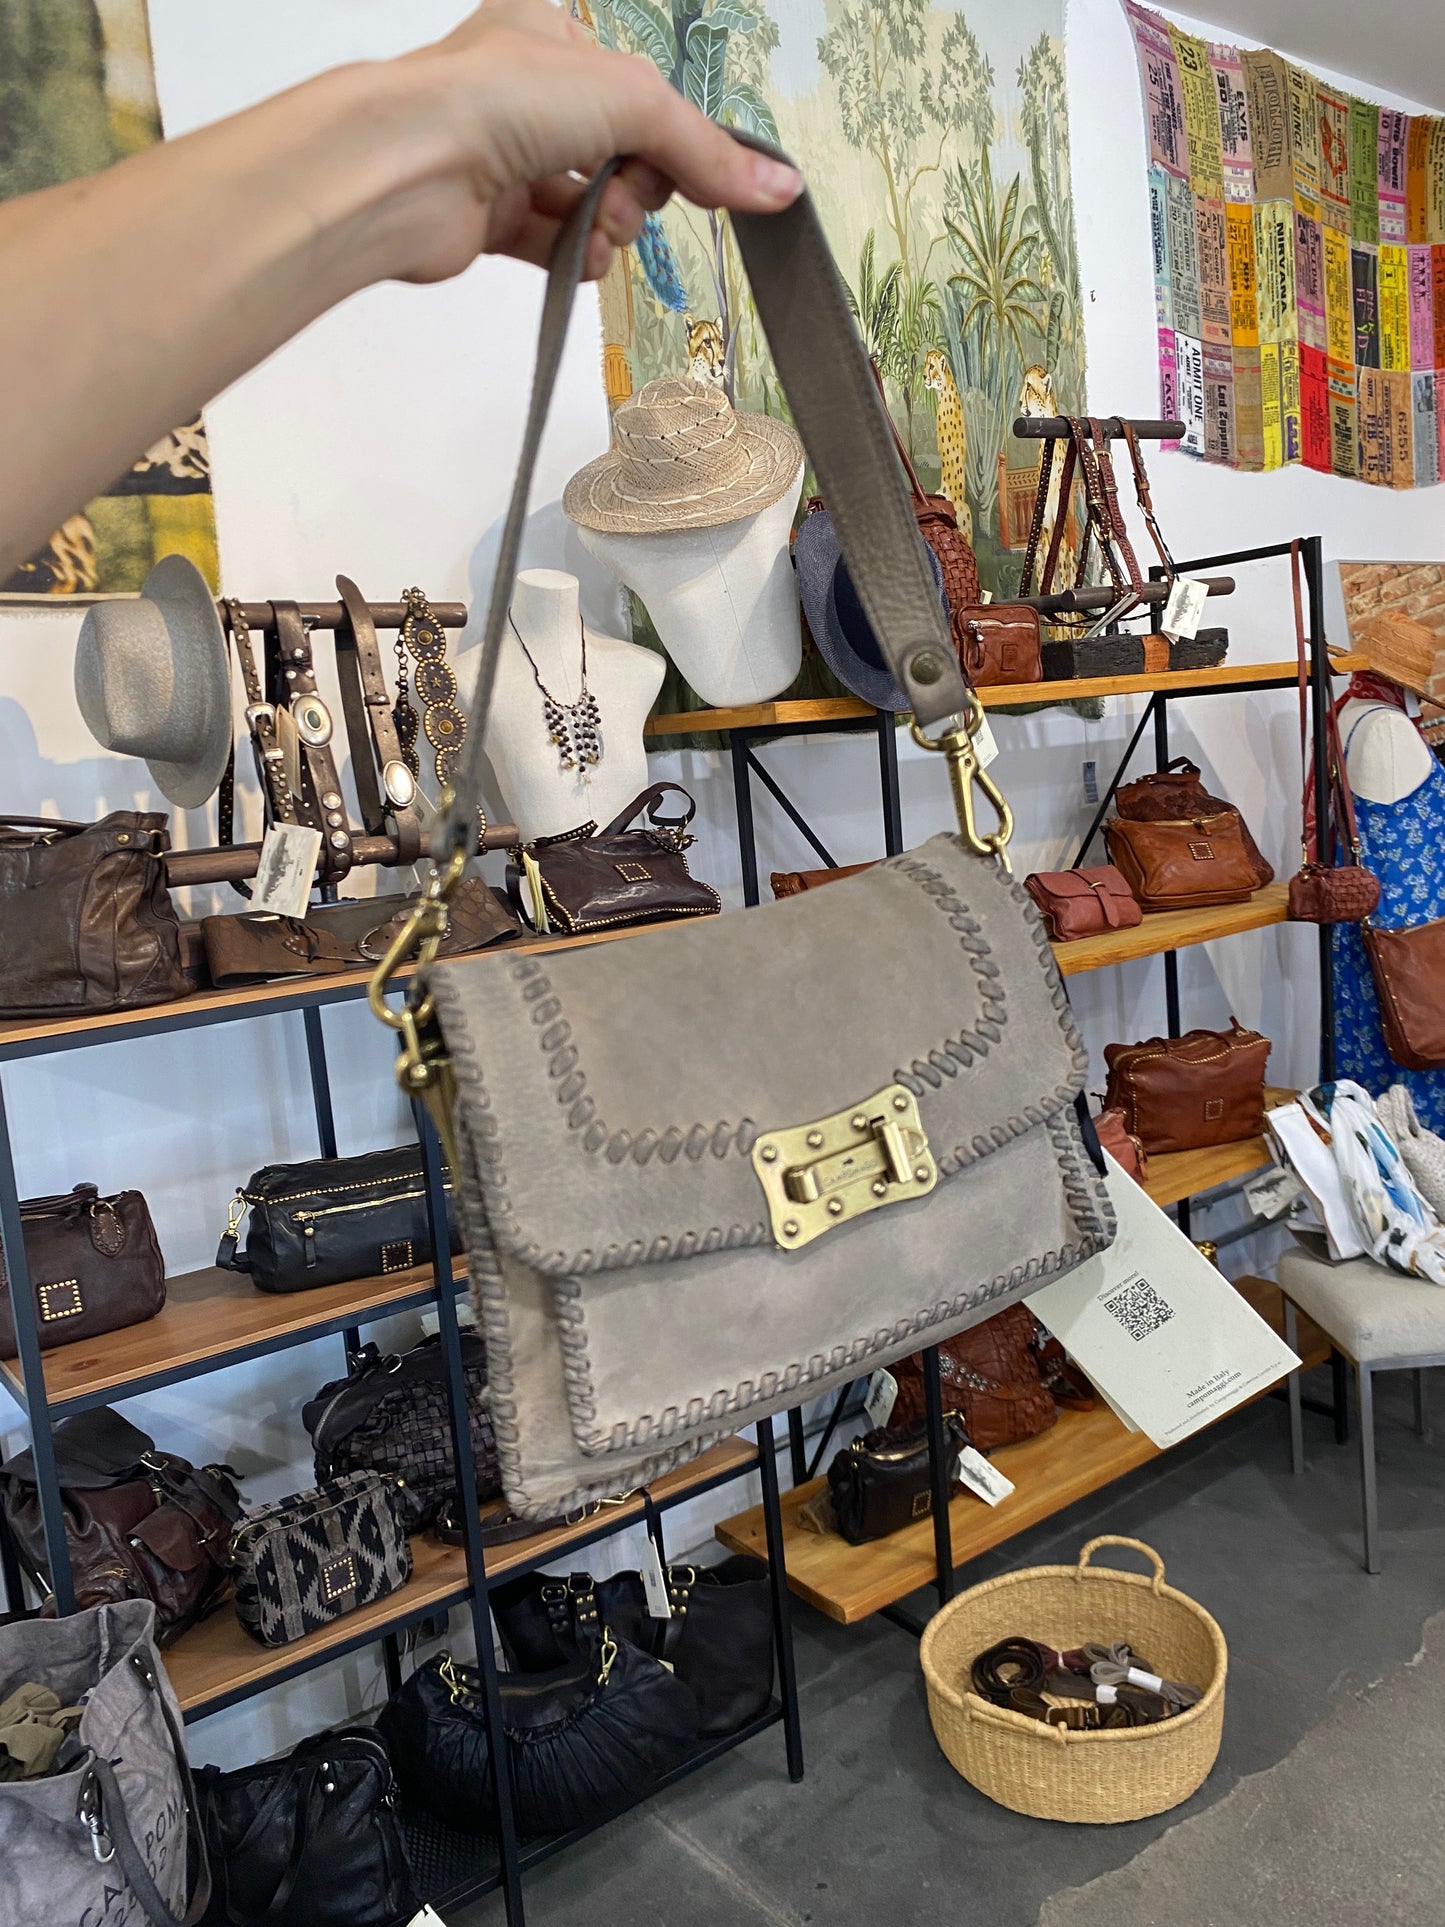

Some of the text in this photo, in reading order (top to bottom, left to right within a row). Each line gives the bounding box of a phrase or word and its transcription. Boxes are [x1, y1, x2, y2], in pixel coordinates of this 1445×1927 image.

[1179, 42, 1197, 71] 23
[1148, 63, 1159, 87] 25
[1217, 74, 1227, 103] 30
[1291, 70, 1303, 90] 18
[1236, 91, 1248, 141] ELVIS
[1292, 92, 1303, 151] PRINCE
[1381, 113, 1390, 129] 10
[1230, 225, 1237, 241] 27
[1276, 222, 1287, 314] NIRVANA
[1356, 288, 1369, 348] FLYD
[1366, 290, 1374, 335] PINK
[1191, 347, 1203, 423] ADMIT ONE
[1217, 384, 1227, 408] Led
[1398, 411, 1408, 462] 6255
[1097, 1270, 1139, 1301] Discover more!
[1186, 1385, 1206, 1398] Made
[1213, 1369, 1230, 1381] Italy
[1187, 1371, 1242, 1409] campomaggi.com
